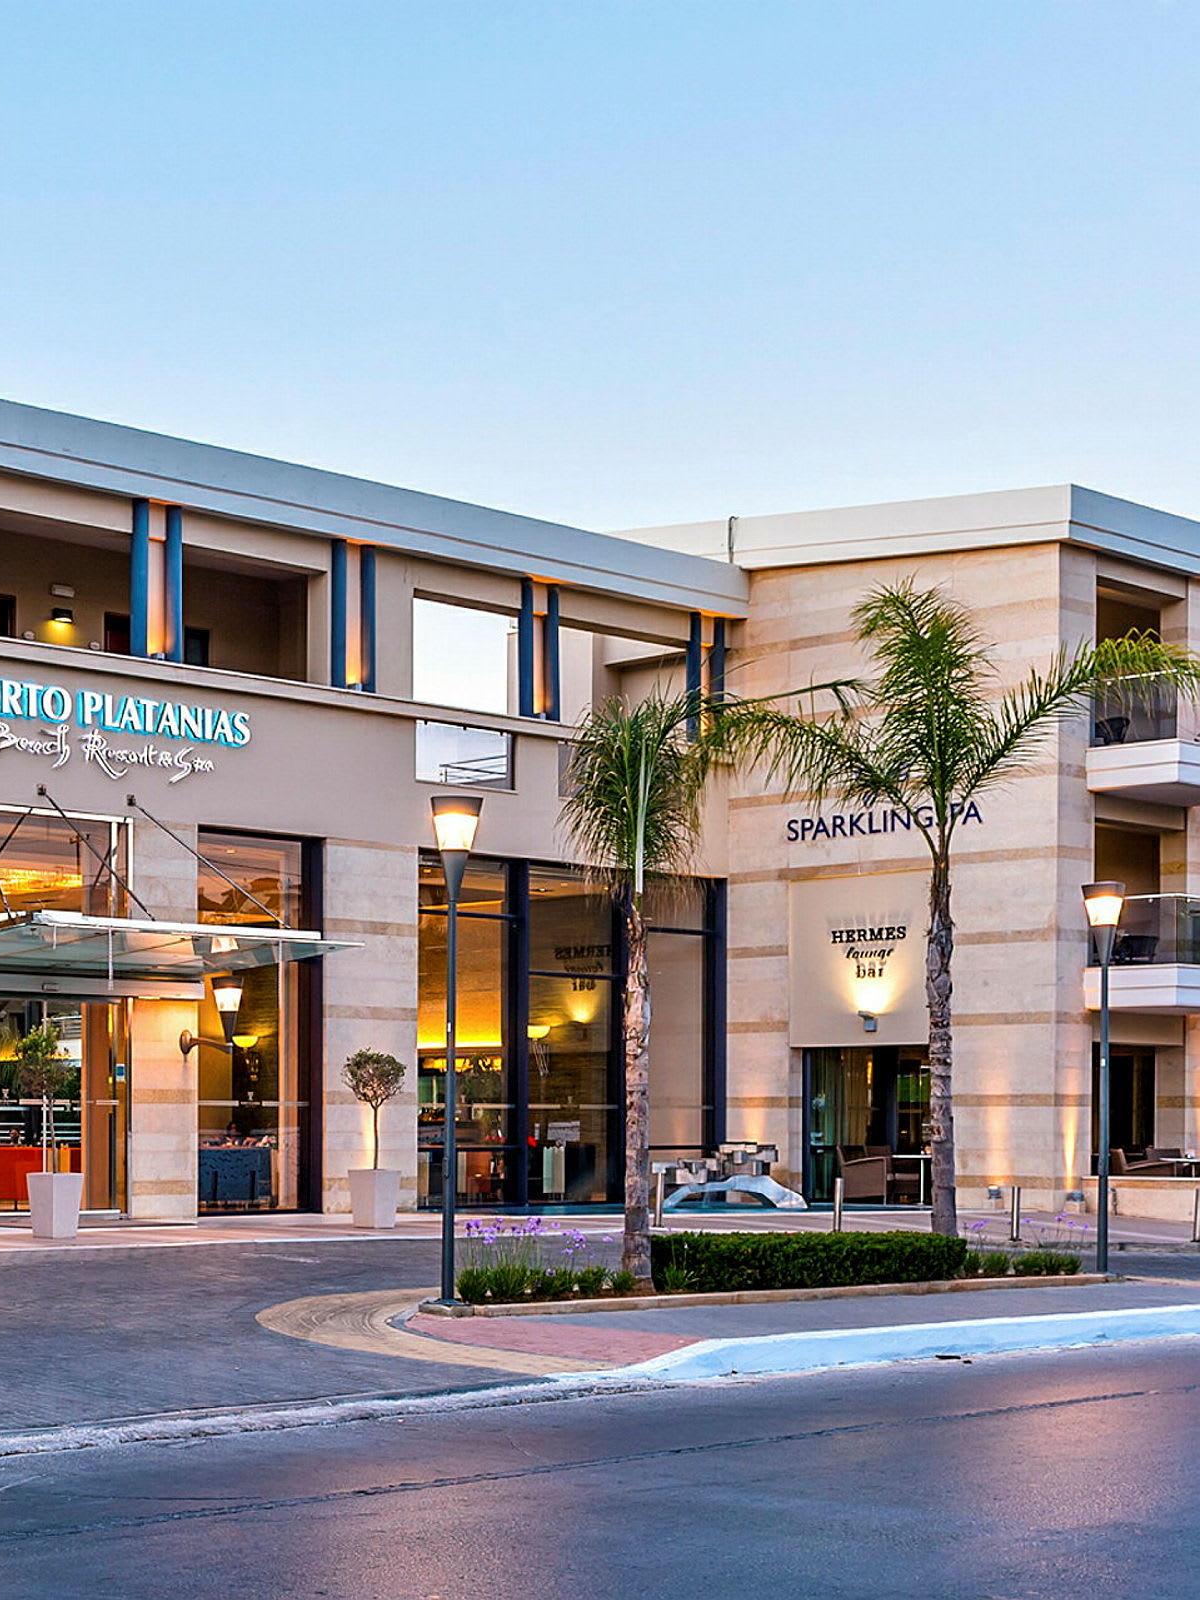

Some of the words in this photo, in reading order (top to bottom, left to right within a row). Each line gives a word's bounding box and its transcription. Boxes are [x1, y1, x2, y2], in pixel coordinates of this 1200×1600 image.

[80, 690, 253, 746] PLATANIAS
[831, 926, 907, 944] HERMES
[856, 965, 884, 978] bar
